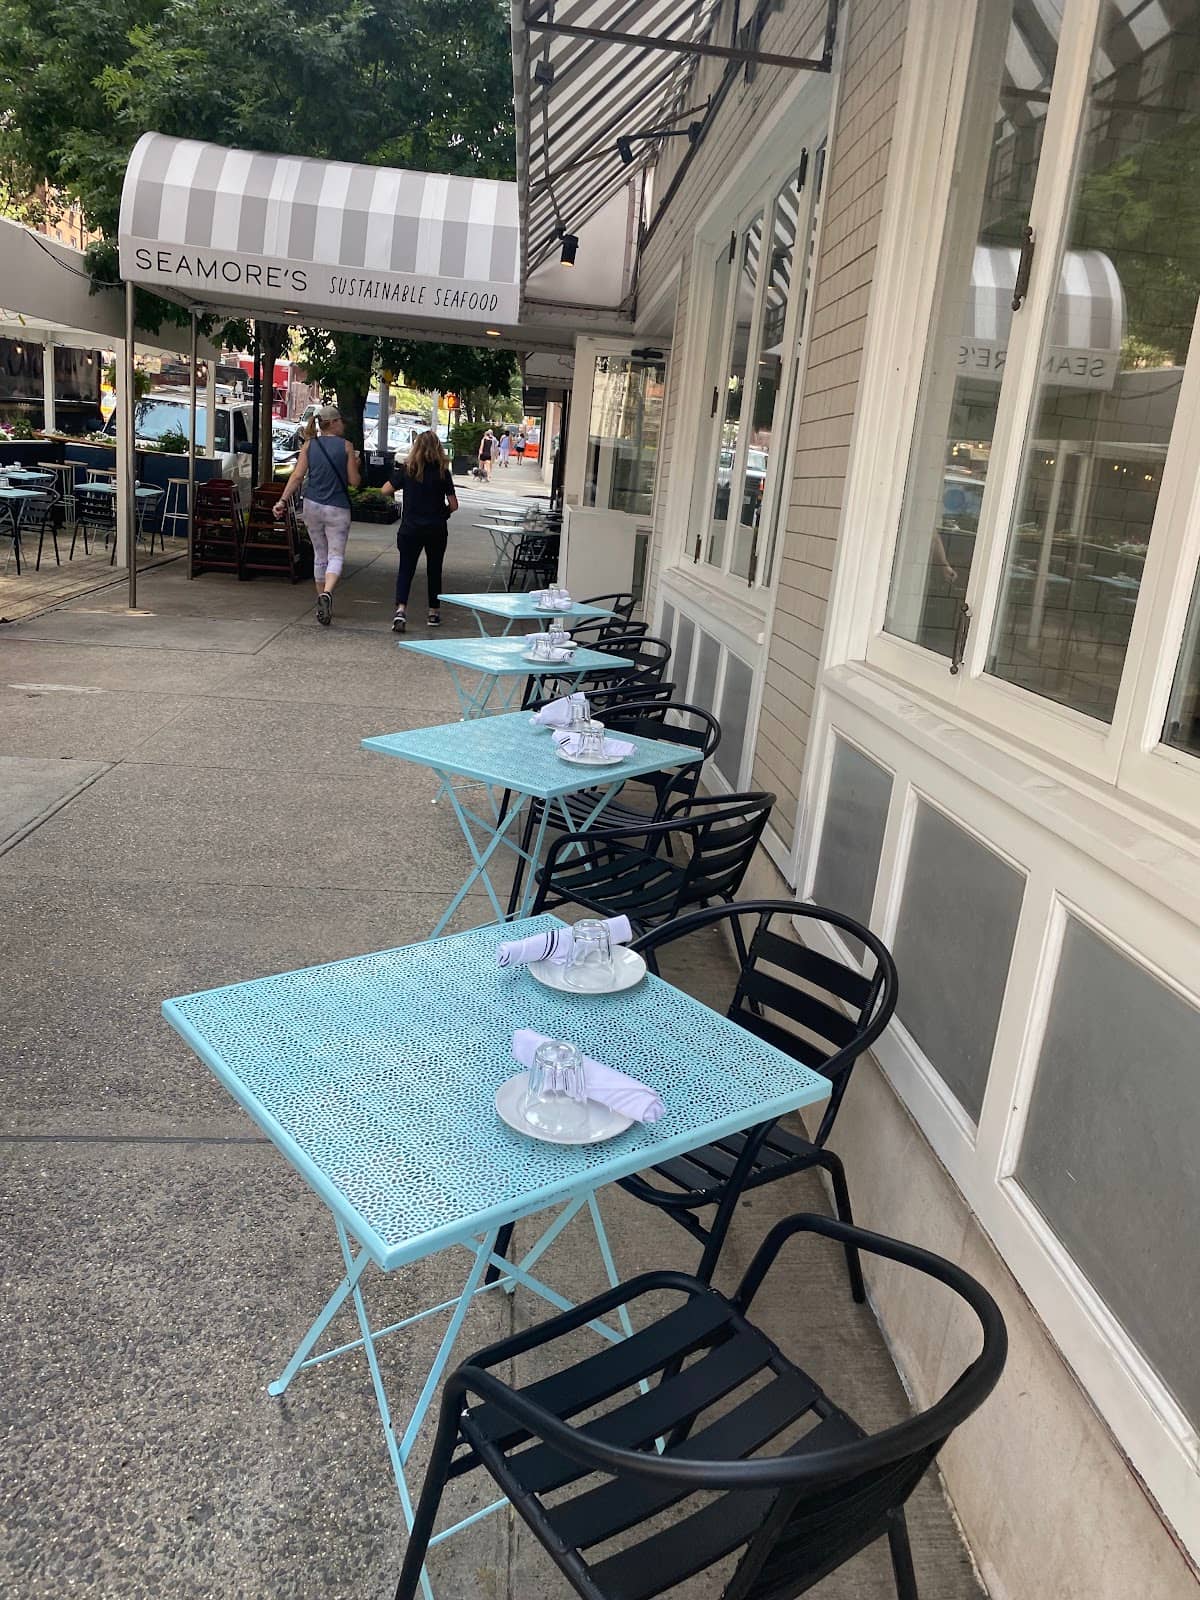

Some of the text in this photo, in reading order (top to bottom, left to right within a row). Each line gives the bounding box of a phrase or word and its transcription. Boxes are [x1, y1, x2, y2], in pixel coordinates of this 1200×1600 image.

[135, 248, 498, 312] SEAMORE'S SUSTAINABLE SEAFOOD
